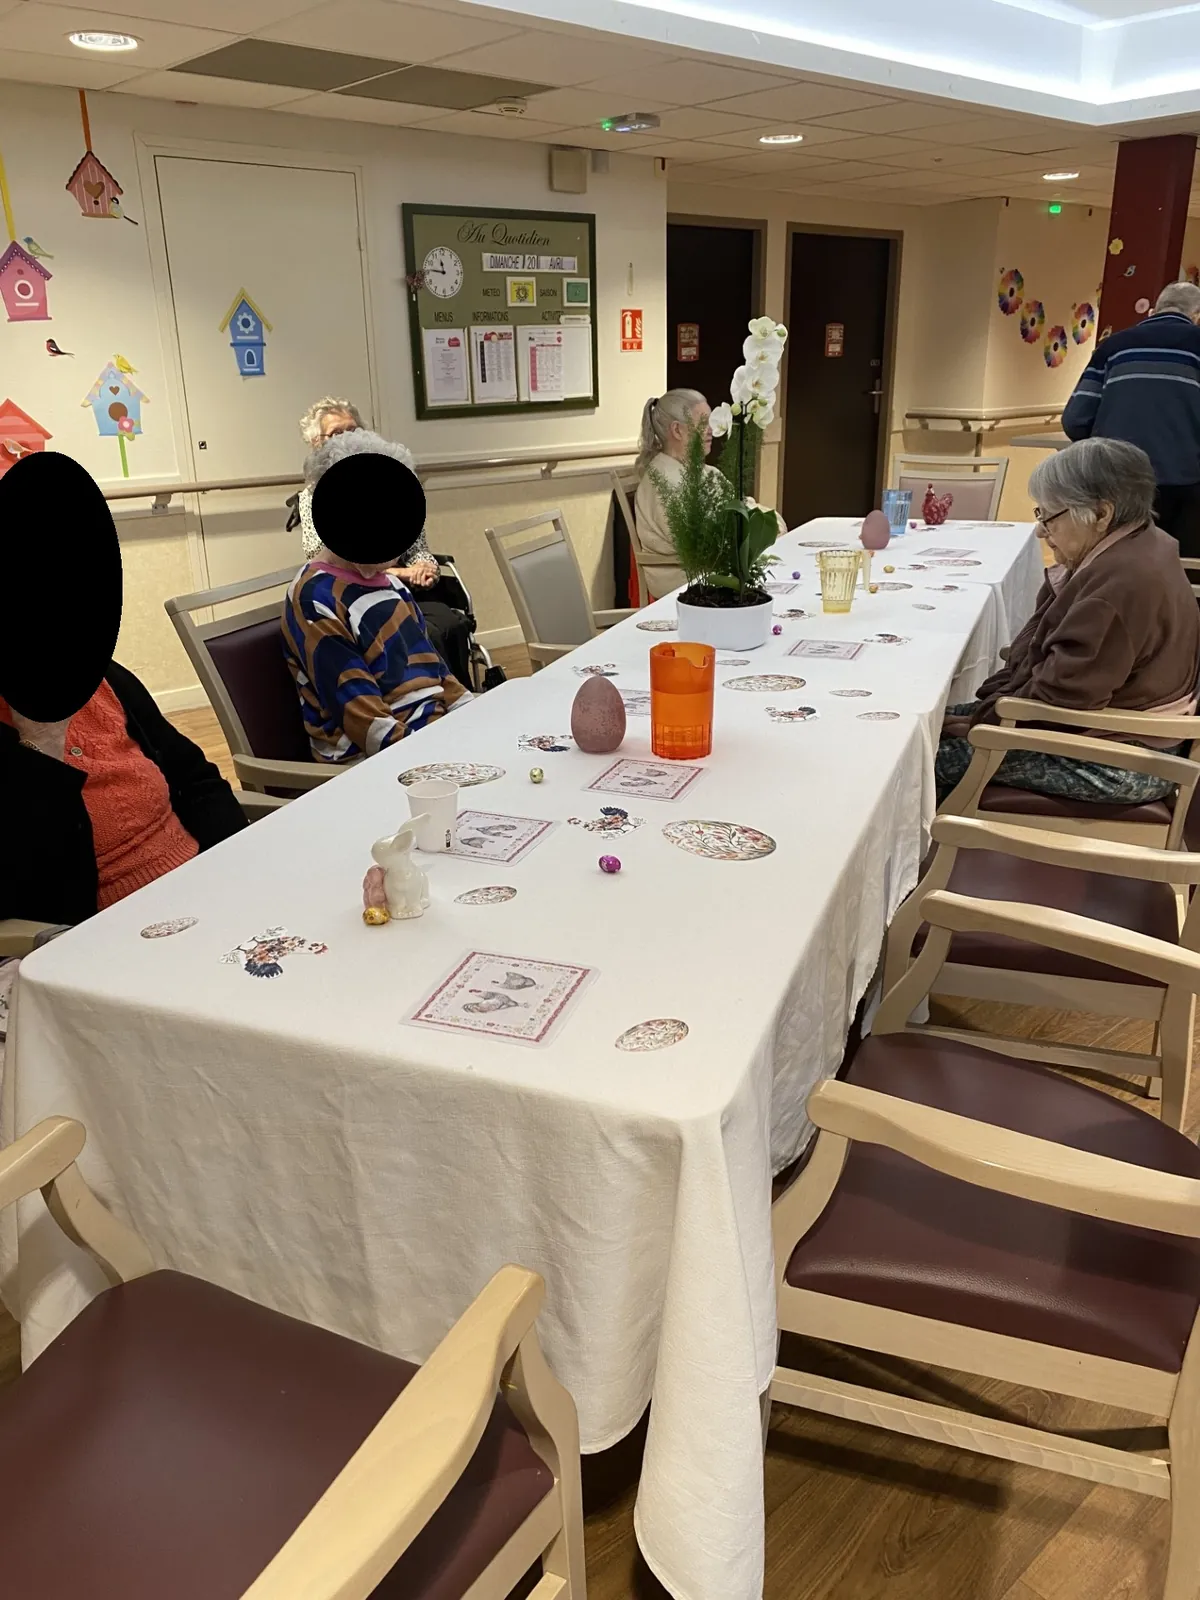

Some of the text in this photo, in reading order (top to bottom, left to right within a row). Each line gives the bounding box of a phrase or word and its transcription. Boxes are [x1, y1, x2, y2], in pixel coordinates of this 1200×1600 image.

[457, 220, 550, 247] Au Quotidien
[489, 255, 565, 270] DIMANCHE 20 AVRIL
[539, 288, 558, 297] SAISON
[433, 311, 454, 322] MENUS
[472, 310, 510, 322] INFORMATIONS
